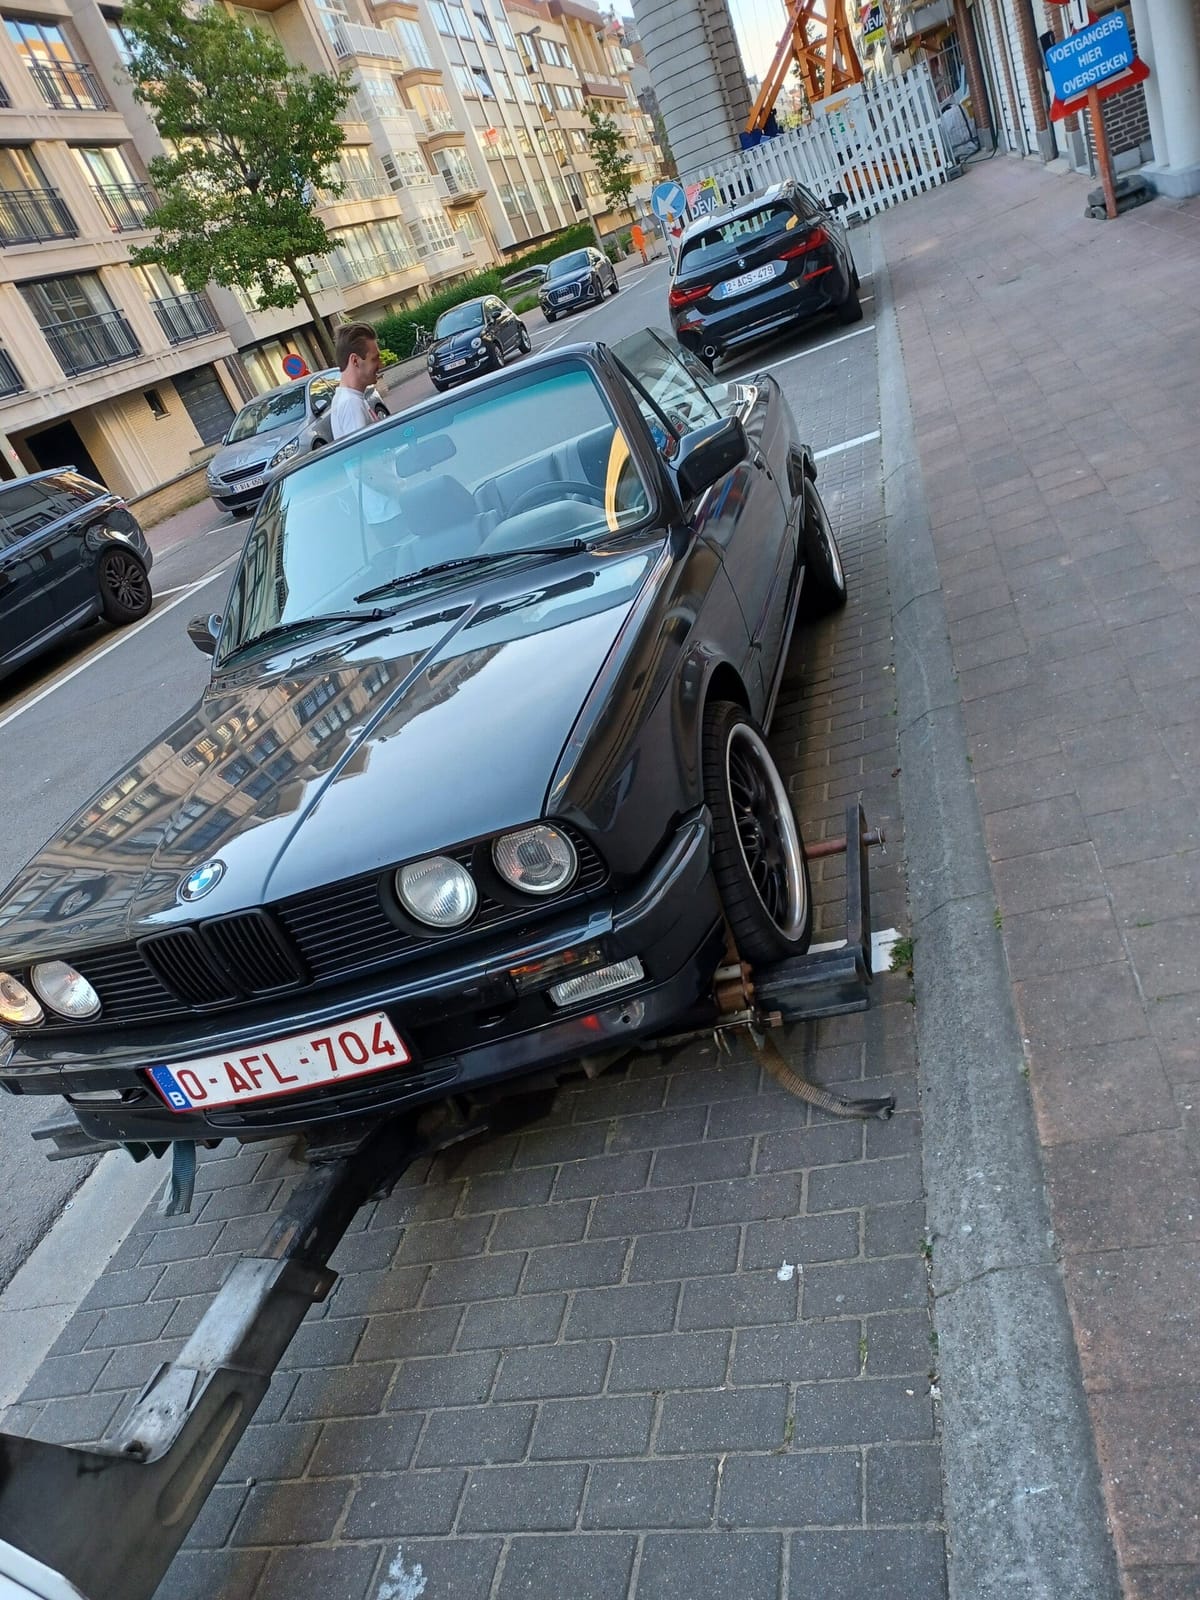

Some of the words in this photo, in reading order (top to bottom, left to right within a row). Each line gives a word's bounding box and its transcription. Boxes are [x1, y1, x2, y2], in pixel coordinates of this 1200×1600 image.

[1049, 16, 1124, 64] VOETGANGERS
[1077, 46, 1103, 68] HIER
[1062, 51, 1129, 94] OVERSTEKEN
[690, 196, 719, 219] DEVA
[726, 264, 773, 292] 2-ACS-479
[167, 1091, 186, 1107] B
